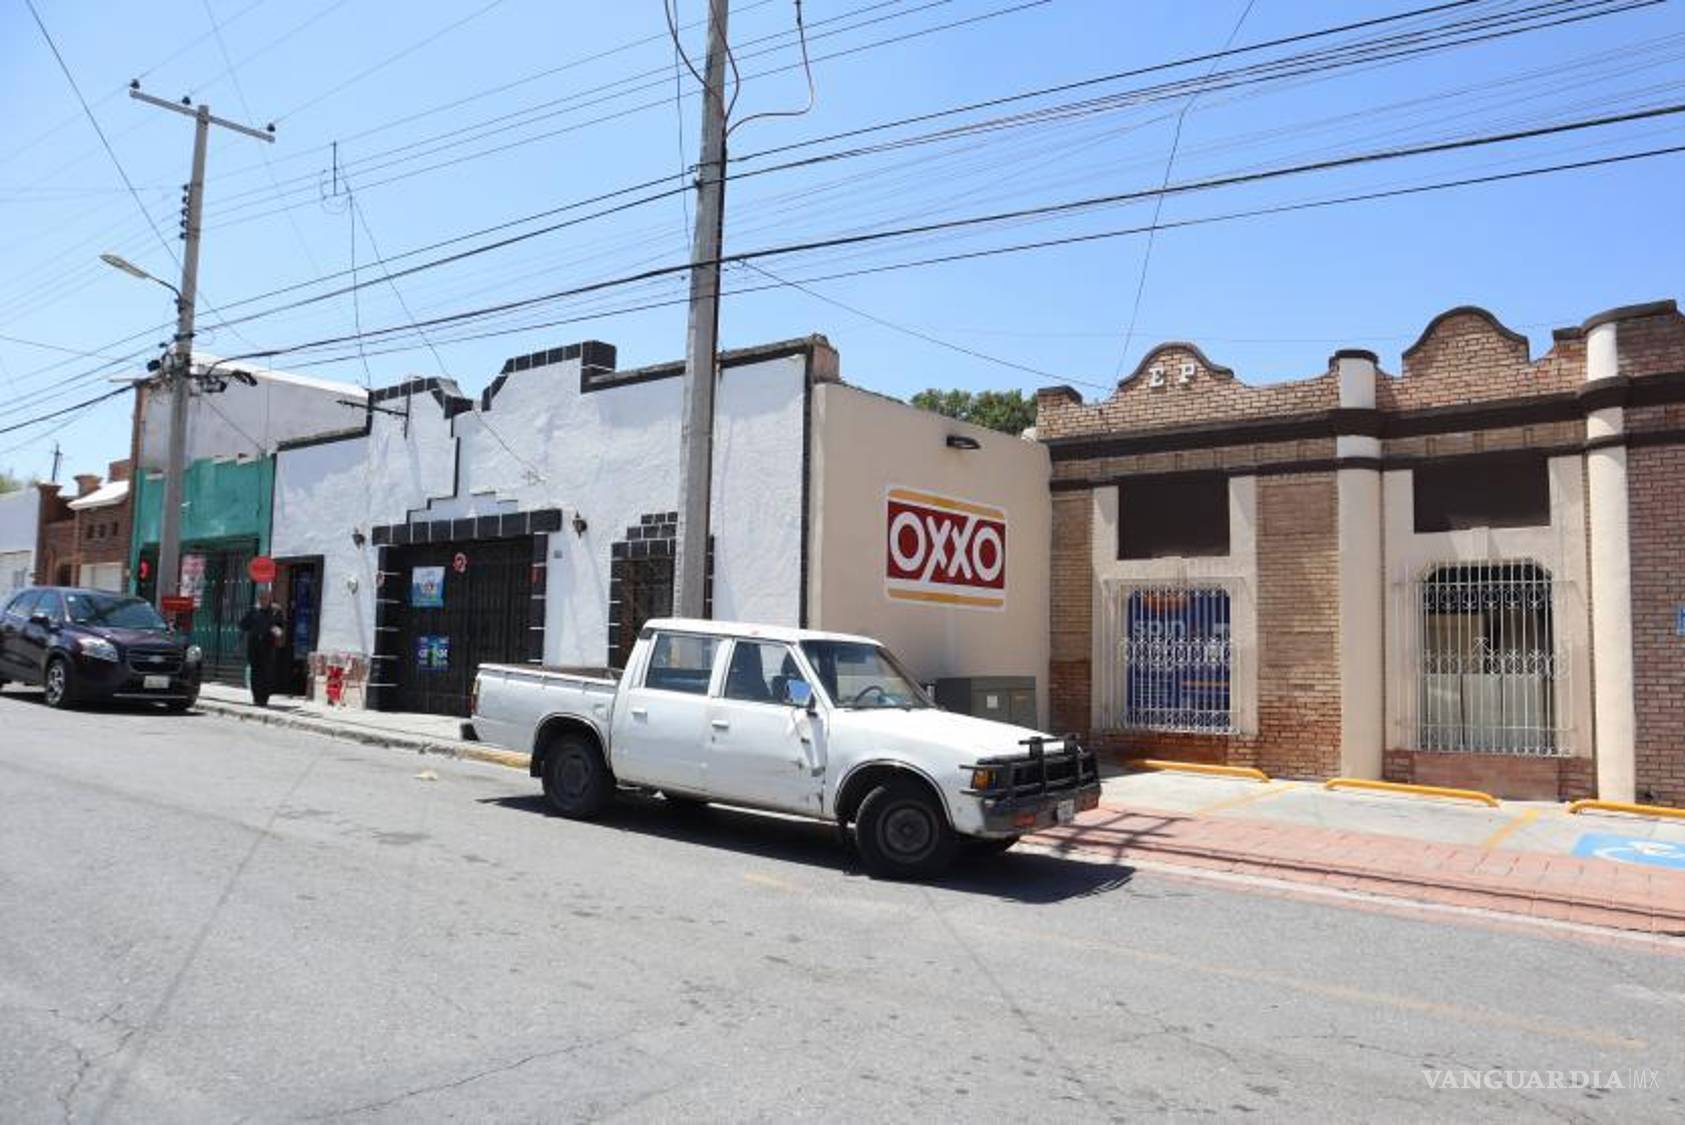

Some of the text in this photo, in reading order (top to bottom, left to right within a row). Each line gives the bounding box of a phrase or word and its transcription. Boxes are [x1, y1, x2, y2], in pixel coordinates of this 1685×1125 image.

[1149, 363, 1195, 387] E P
[889, 510, 1003, 582] OXXO
